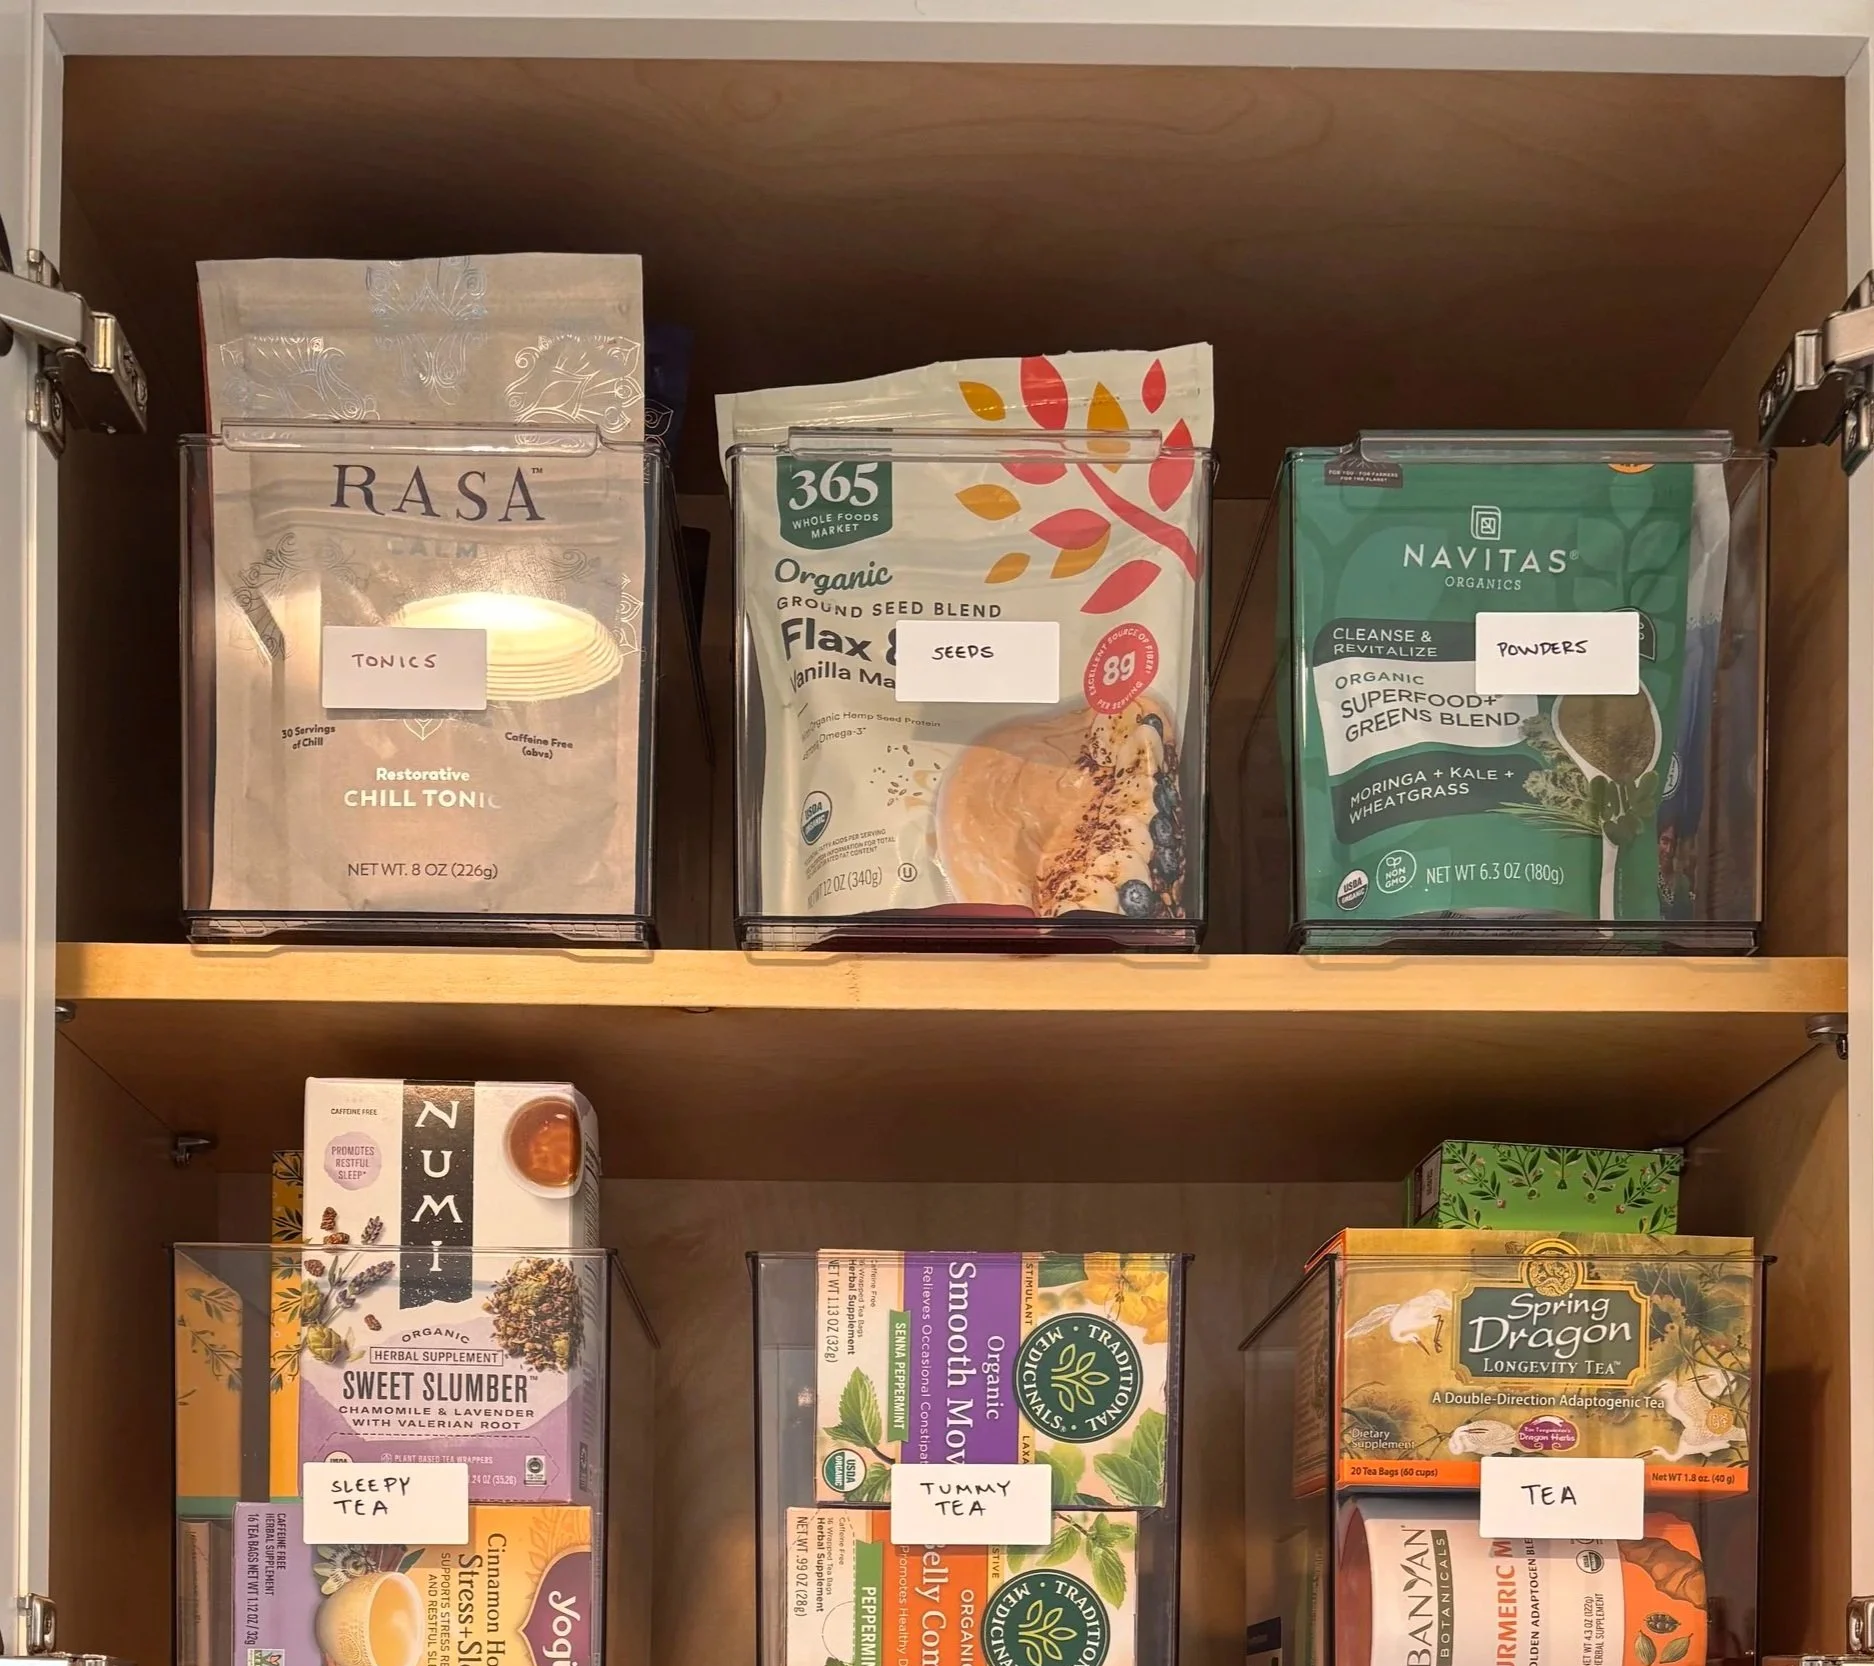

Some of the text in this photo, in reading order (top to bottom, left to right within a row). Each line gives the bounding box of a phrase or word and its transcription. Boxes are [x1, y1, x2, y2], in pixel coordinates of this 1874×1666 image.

[789, 462, 880, 511] 365
[793, 513, 879, 530] WHOLE FOODS
[812, 524, 860, 538] MARKET
[775, 558, 893, 595] Organic
[1445, 576, 1521, 590] ORGANICS
[777, 597, 1002, 618] GROUND SEED BLEND
[781, 619, 872, 662] Flax
[1498, 640, 1588, 658] POWDERS
[932, 646, 994, 660] SEEDS
[1333, 644, 1437, 657] REVITALIZE
[352, 654, 437, 669] TONICS
[1103, 651, 1135, 687] 8g
[1335, 673, 1424, 689] ORGANIC
[281, 725, 336, 739] 30 Servings
[1345, 708, 1520, 743] GREENS BLEND
[505, 732, 573, 749] Caffeine Free
[376, 768, 469, 782] Restorative
[344, 790, 416, 807] CHILL
[348, 863, 497, 880] NET WT. 8 OZ (226g)
[1426, 863, 1564, 885] NET WT 6.3 OZ (180g)
[411, 1100, 463, 1273] NUMI
[1508, 1293, 1610, 1325] Spring
[947, 1262, 976, 1388] Smooth
[402, 1328, 470, 1344] ORGANIC
[1469, 1317, 1632, 1358] Dragon
[375, 1351, 498, 1363] HERBAL SUPPLEMENT
[894, 1323, 906, 1429] SENNA PEPPERMINT
[982, 1335, 1005, 1419] Organic
[1084, 1323, 1133, 1432] TRADITIONAL
[343, 1371, 413, 1400] SWEET
[1433, 1392, 1665, 1409] A Double-Direction Adaptogenic Tea
[339, 1406, 534, 1418] CHAMOMILE & LAVENDER
[352, 1418, 521, 1430] WITH VALERIAN ROOT
[1352, 1429, 1390, 1441] Dietary
[1352, 1440, 1414, 1450] Supplement
[331, 1477, 410, 1496] SLEEPY
[921, 1481, 1011, 1497] TUMMY
[1522, 1485, 1577, 1505] TEA
[334, 1499, 388, 1516] TEA
[935, 1500, 986, 1517] TEA
[486, 1533, 507, 1633] Cinnamon
[1436, 1536, 1452, 1659] BOTANICALS
